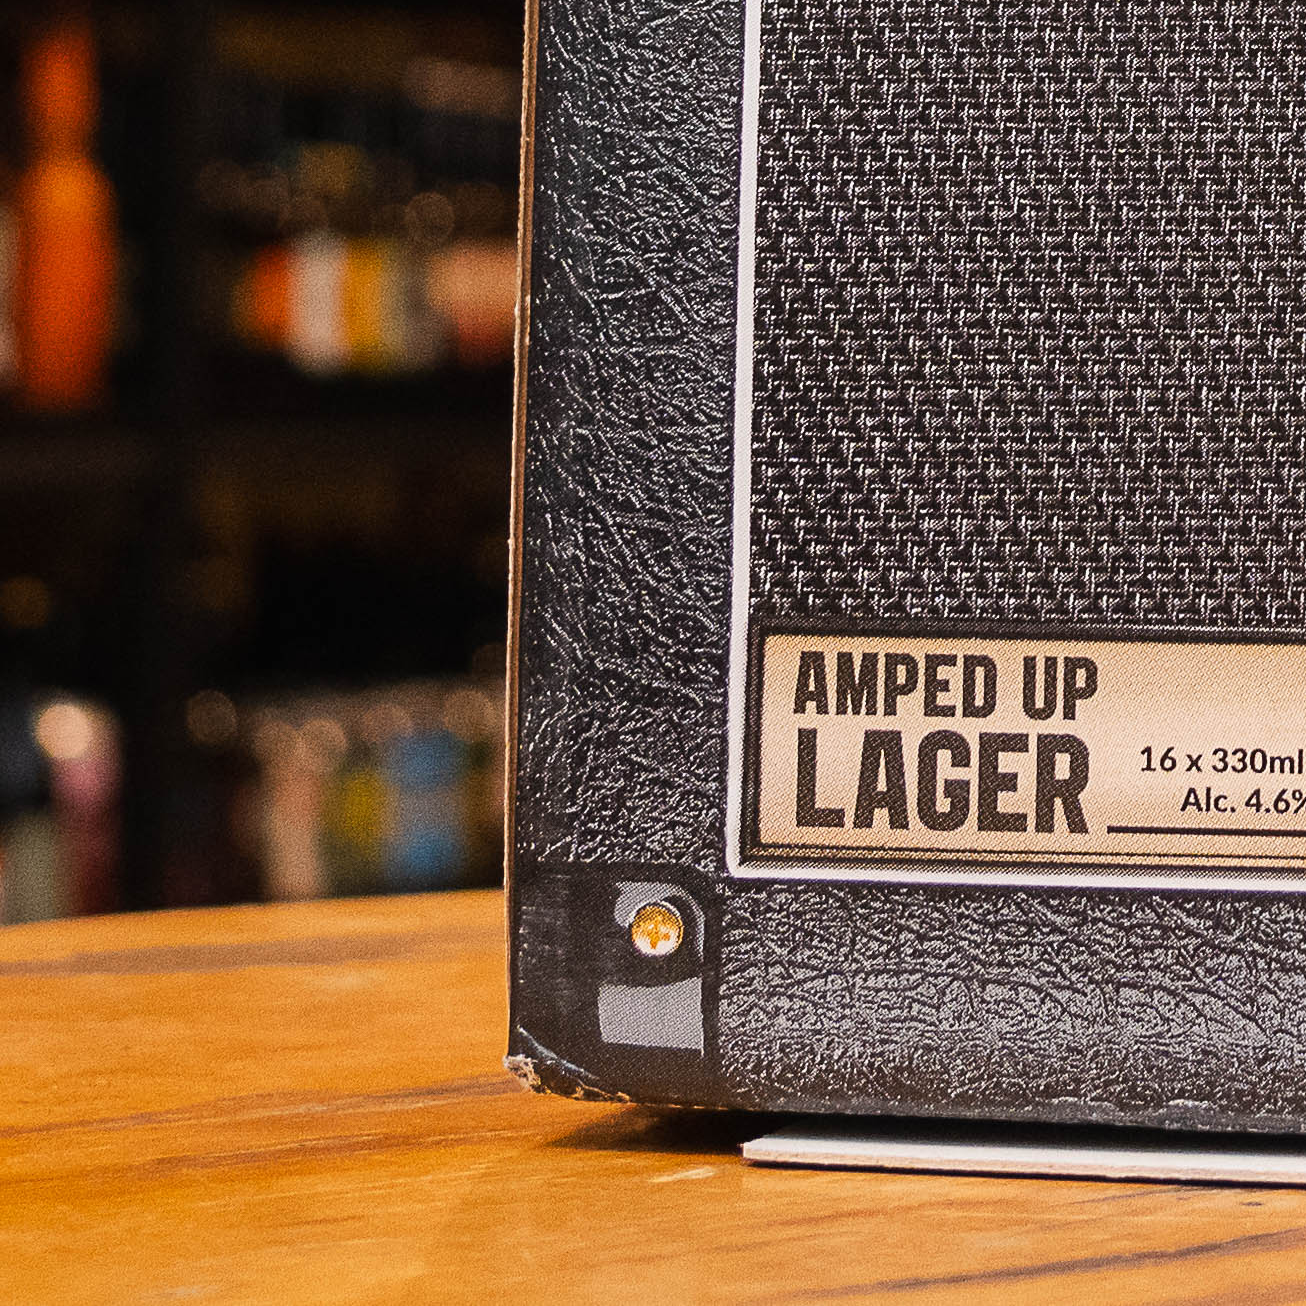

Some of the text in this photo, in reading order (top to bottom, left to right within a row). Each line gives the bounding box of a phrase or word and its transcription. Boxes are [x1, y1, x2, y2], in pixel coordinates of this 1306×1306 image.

[793, 651, 1099, 721] AMPED UP
[795, 727, 1090, 834] LAGER
[1140, 746, 1177, 773] 16
[1184, 754, 1204, 773] x
[1211, 747, 1305, 775] 330ml
[1180, 786, 1237, 814] Alc.
